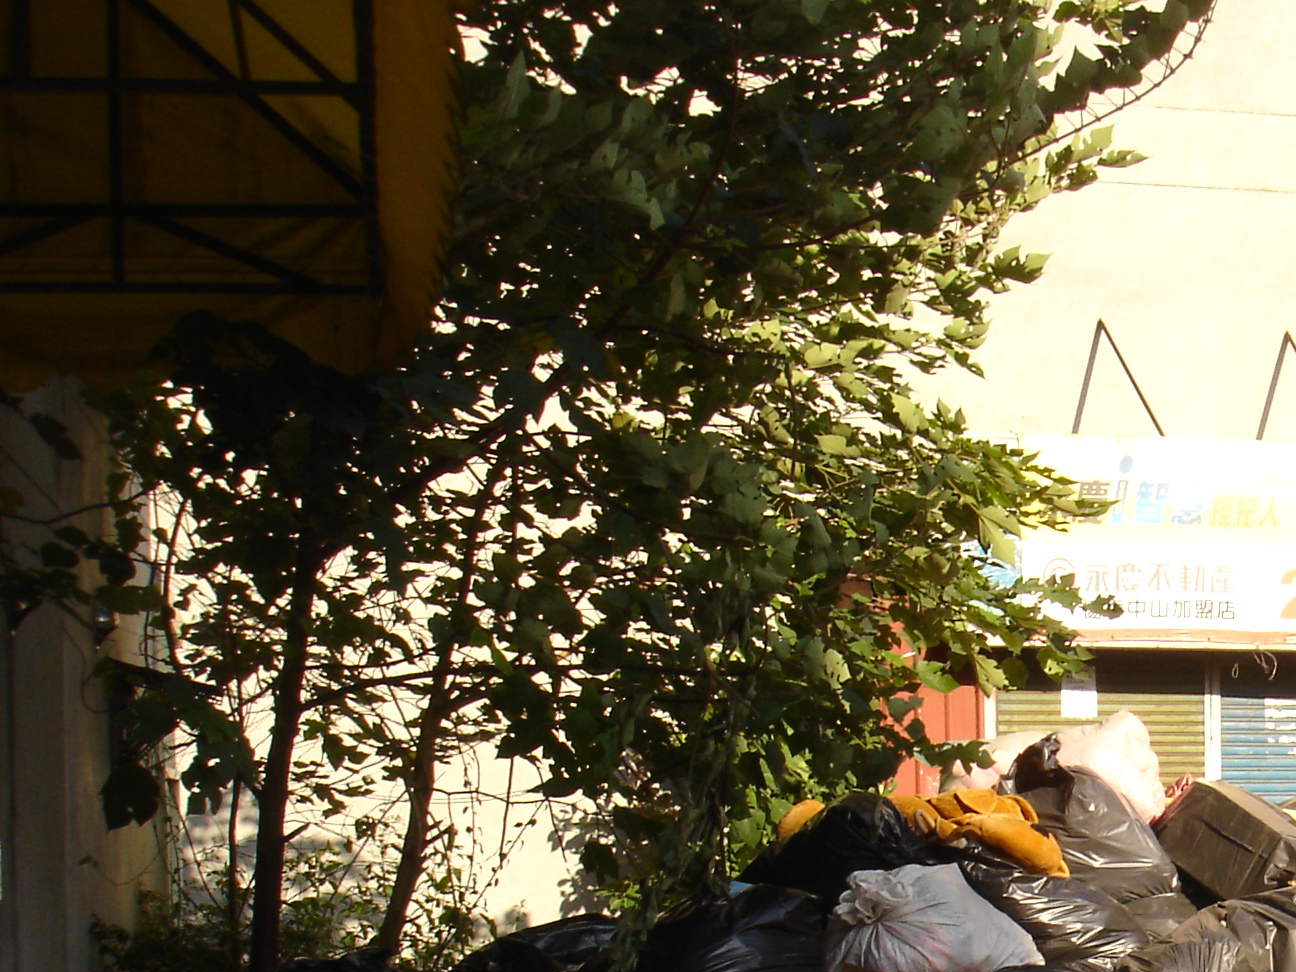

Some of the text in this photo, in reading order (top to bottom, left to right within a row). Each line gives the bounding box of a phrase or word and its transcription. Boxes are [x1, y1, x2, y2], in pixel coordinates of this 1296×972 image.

[1084, 600, 1235, 620] 中山加盟店
